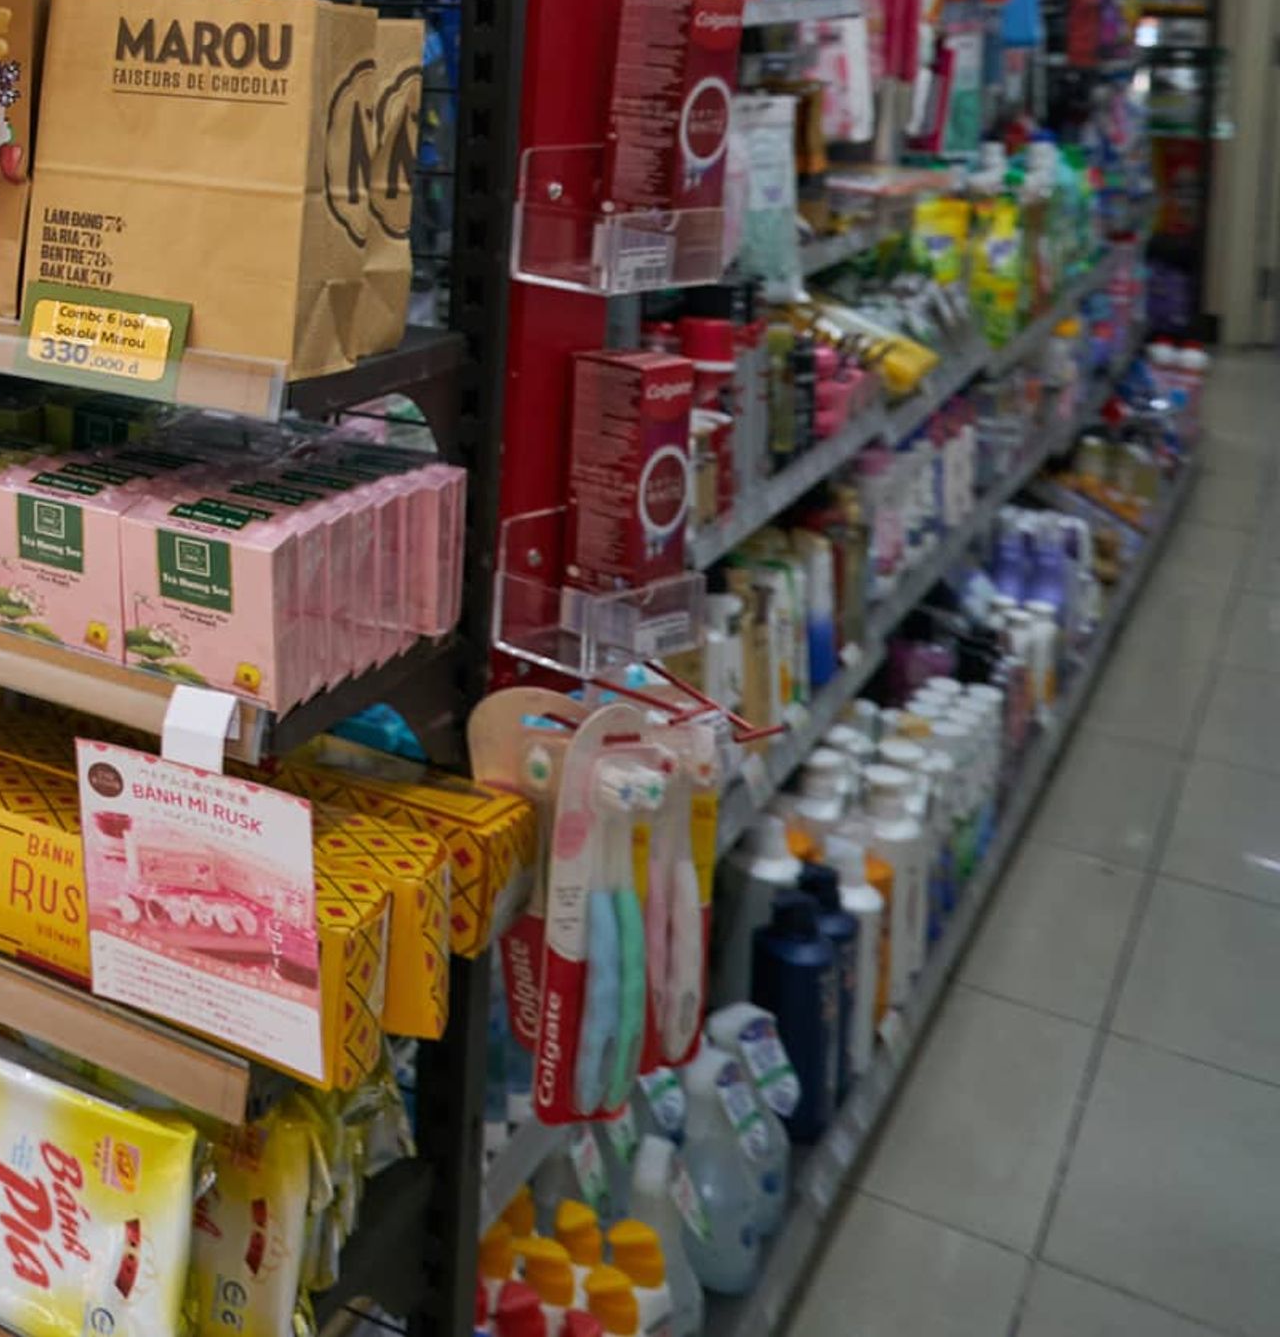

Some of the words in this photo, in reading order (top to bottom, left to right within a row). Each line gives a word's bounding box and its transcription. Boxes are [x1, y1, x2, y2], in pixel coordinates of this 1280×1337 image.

[115, 16, 294, 71] MAROU
[112, 68, 181, 90] FAISEURS
[186, 72, 205, 90] DE
[211, 75, 289, 97] CHOCOLAT
[40, 336, 124, 373] 330.000
[131, 781, 183, 808] BÁNH
[187, 794, 209, 815] MÌ
[212, 803, 264, 836] RUSK
[26, 832, 75, 867] BÁNH
[9, 857, 83, 925] RUS
[509, 937, 541, 1041] Colgate
[539, 991, 562, 1108] Colgate
[39, 1140, 92, 1264] Bánh
